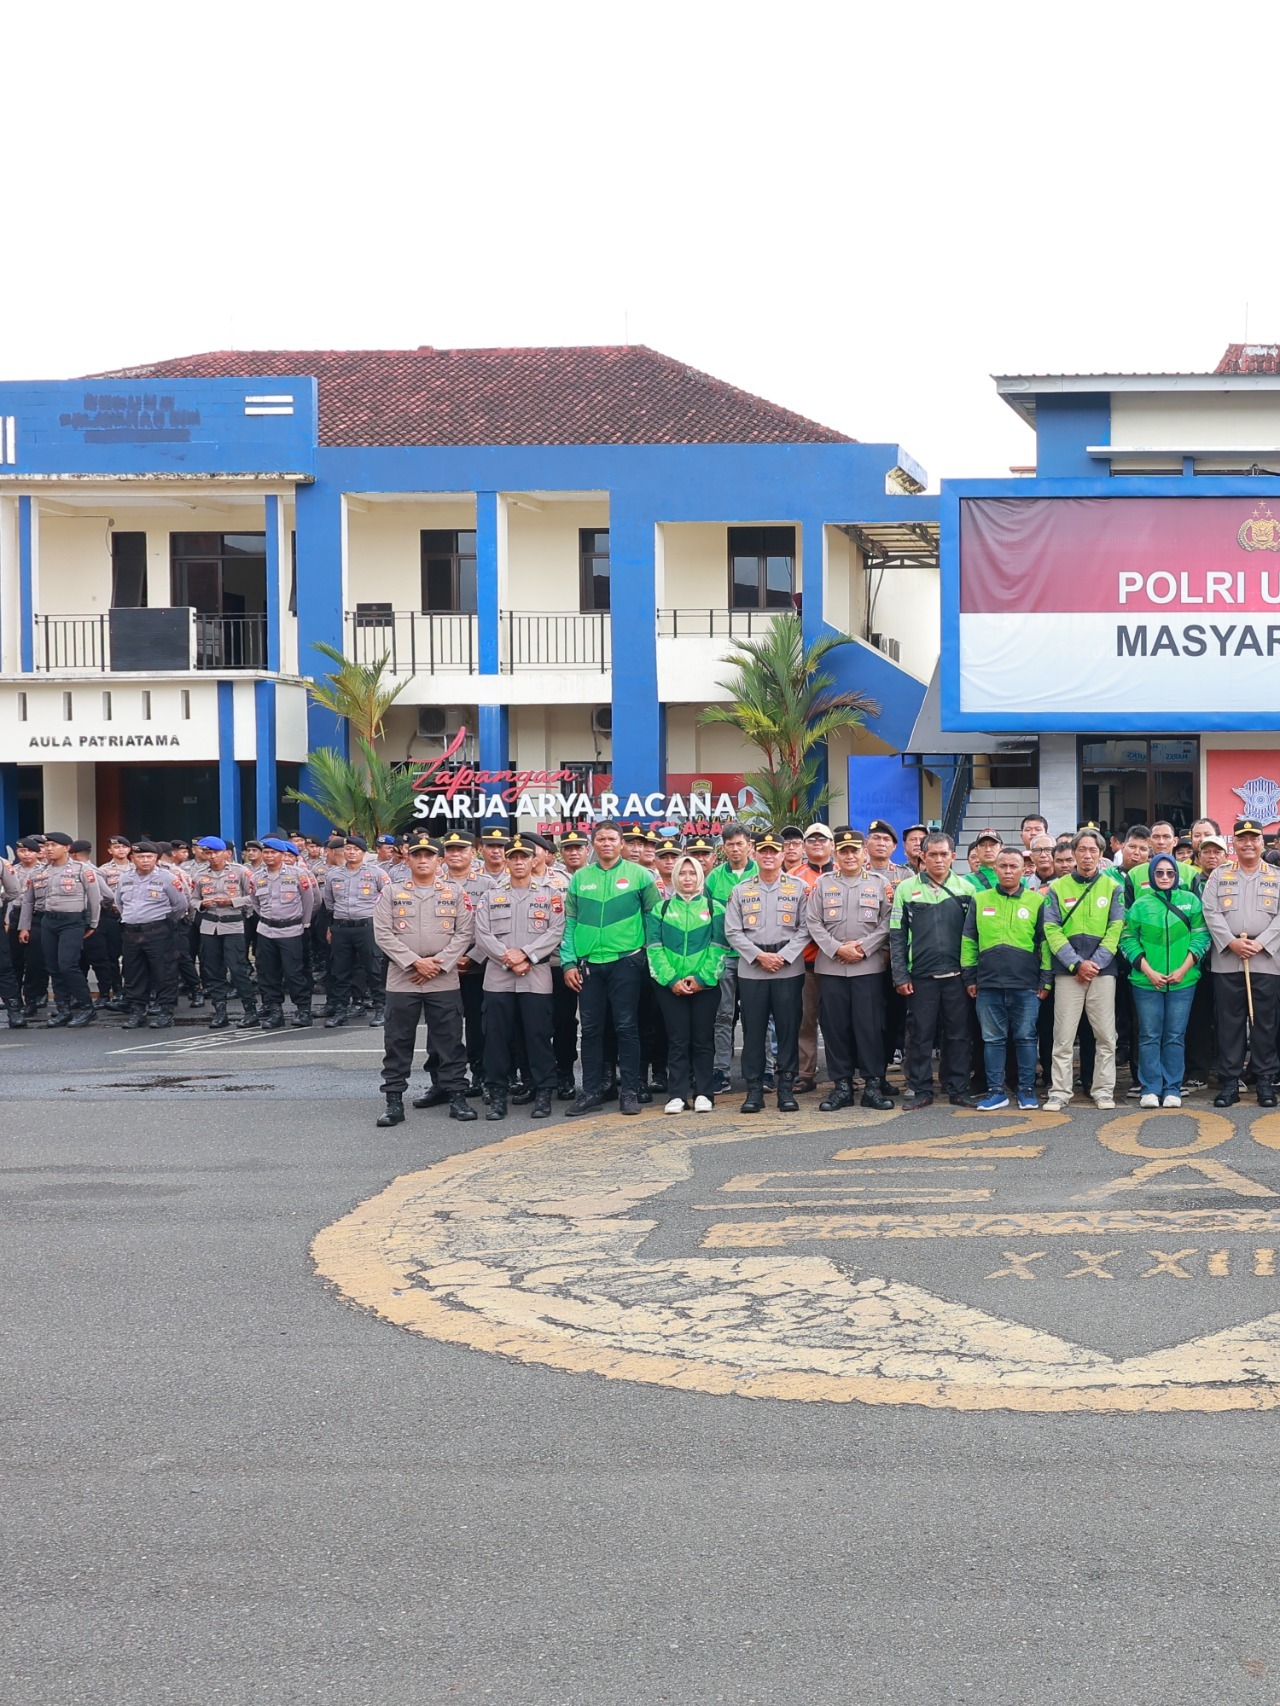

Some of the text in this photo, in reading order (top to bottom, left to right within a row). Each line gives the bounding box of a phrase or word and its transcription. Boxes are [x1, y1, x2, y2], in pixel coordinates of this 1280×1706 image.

[1118, 570, 1246, 605] POLRI
[29, 734, 181, 748] AULA PATRIATAMA
[408, 726, 578, 803] Lapangan
[412, 793, 737, 820] SARJA ARYA RACANA
